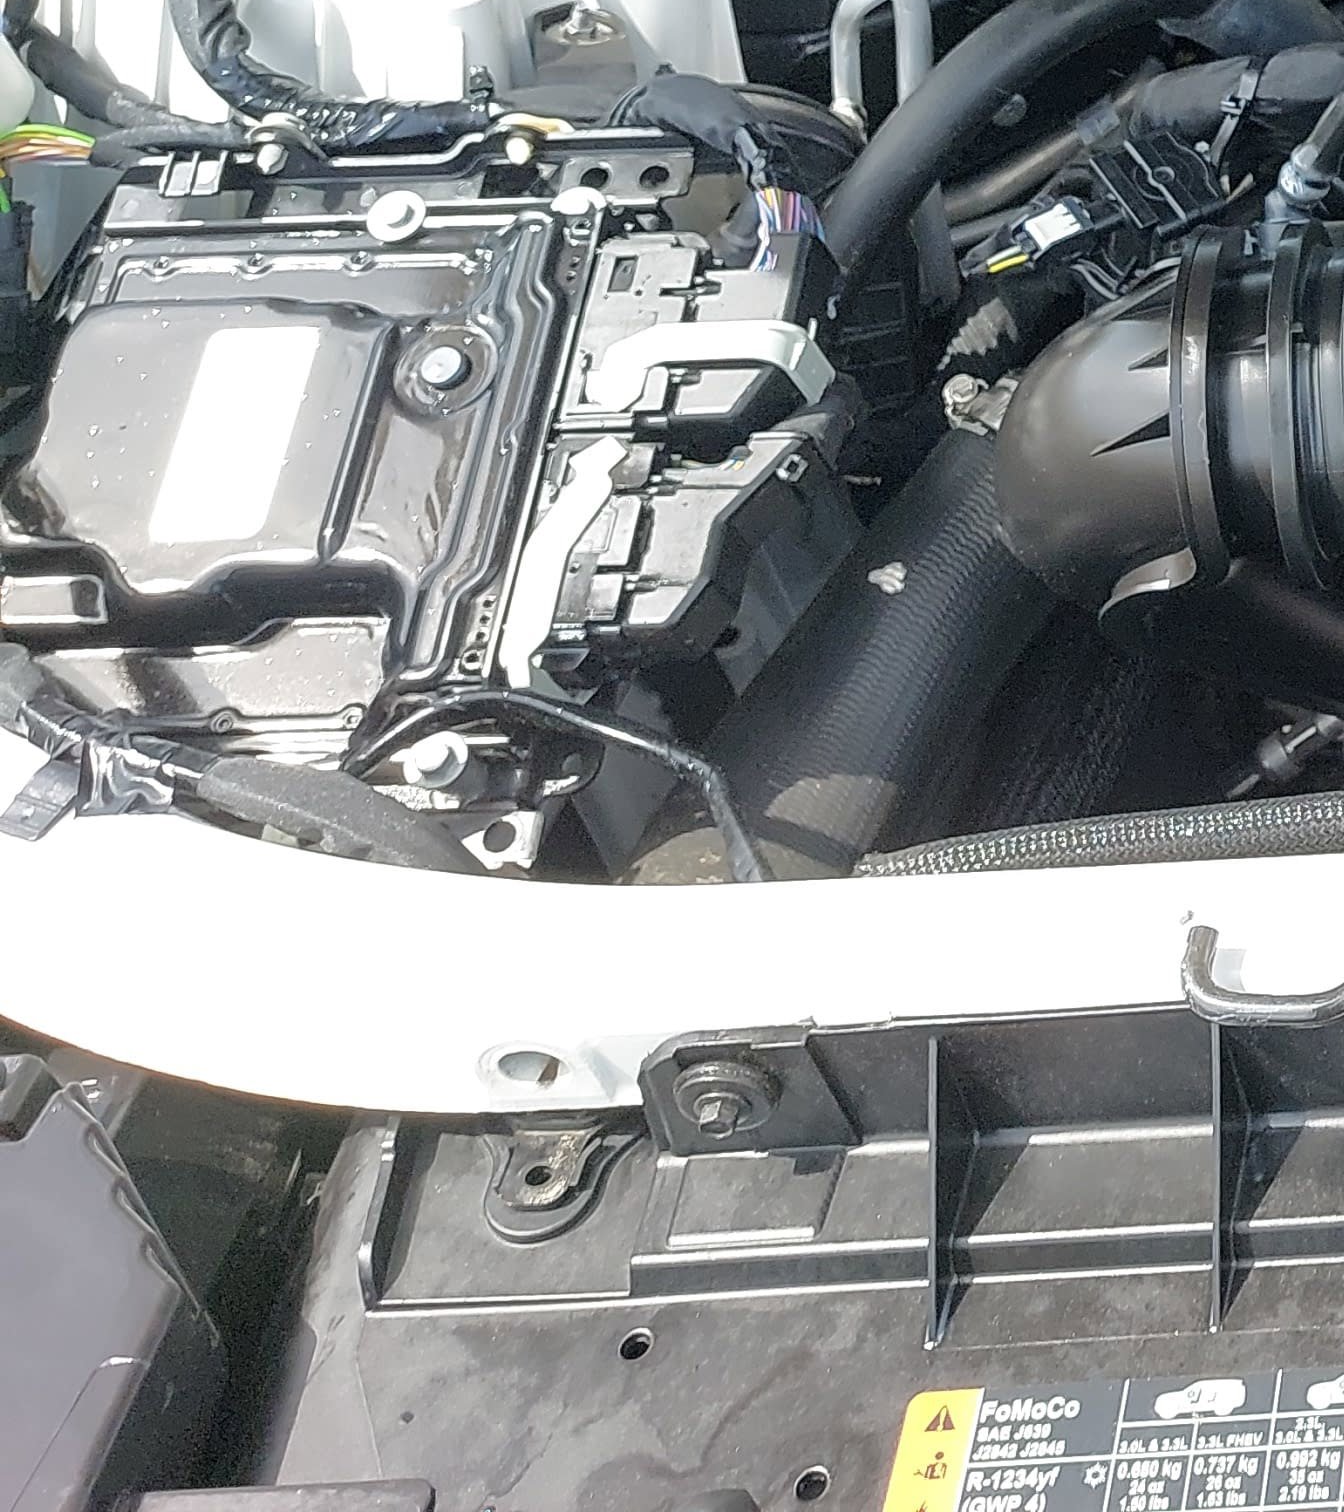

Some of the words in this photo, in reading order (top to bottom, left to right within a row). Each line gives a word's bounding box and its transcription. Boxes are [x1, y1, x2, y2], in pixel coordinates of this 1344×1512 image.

[980, 1396, 1081, 1424] FoMoCo
[976, 1424, 1013, 1443] SAE
[1161, 1458, 1183, 1481] kg
[1193, 1455, 1237, 1476] 0.737
[1238, 1454, 1259, 1477] kg
[1276, 1449, 1319, 1470] 0.992
[1320, 1448, 1341, 1470] kg
[965, 1465, 1061, 1493] R-1234yf
[1128, 1478, 1147, 1496] 24
[1205, 1474, 1223, 1491] 26
